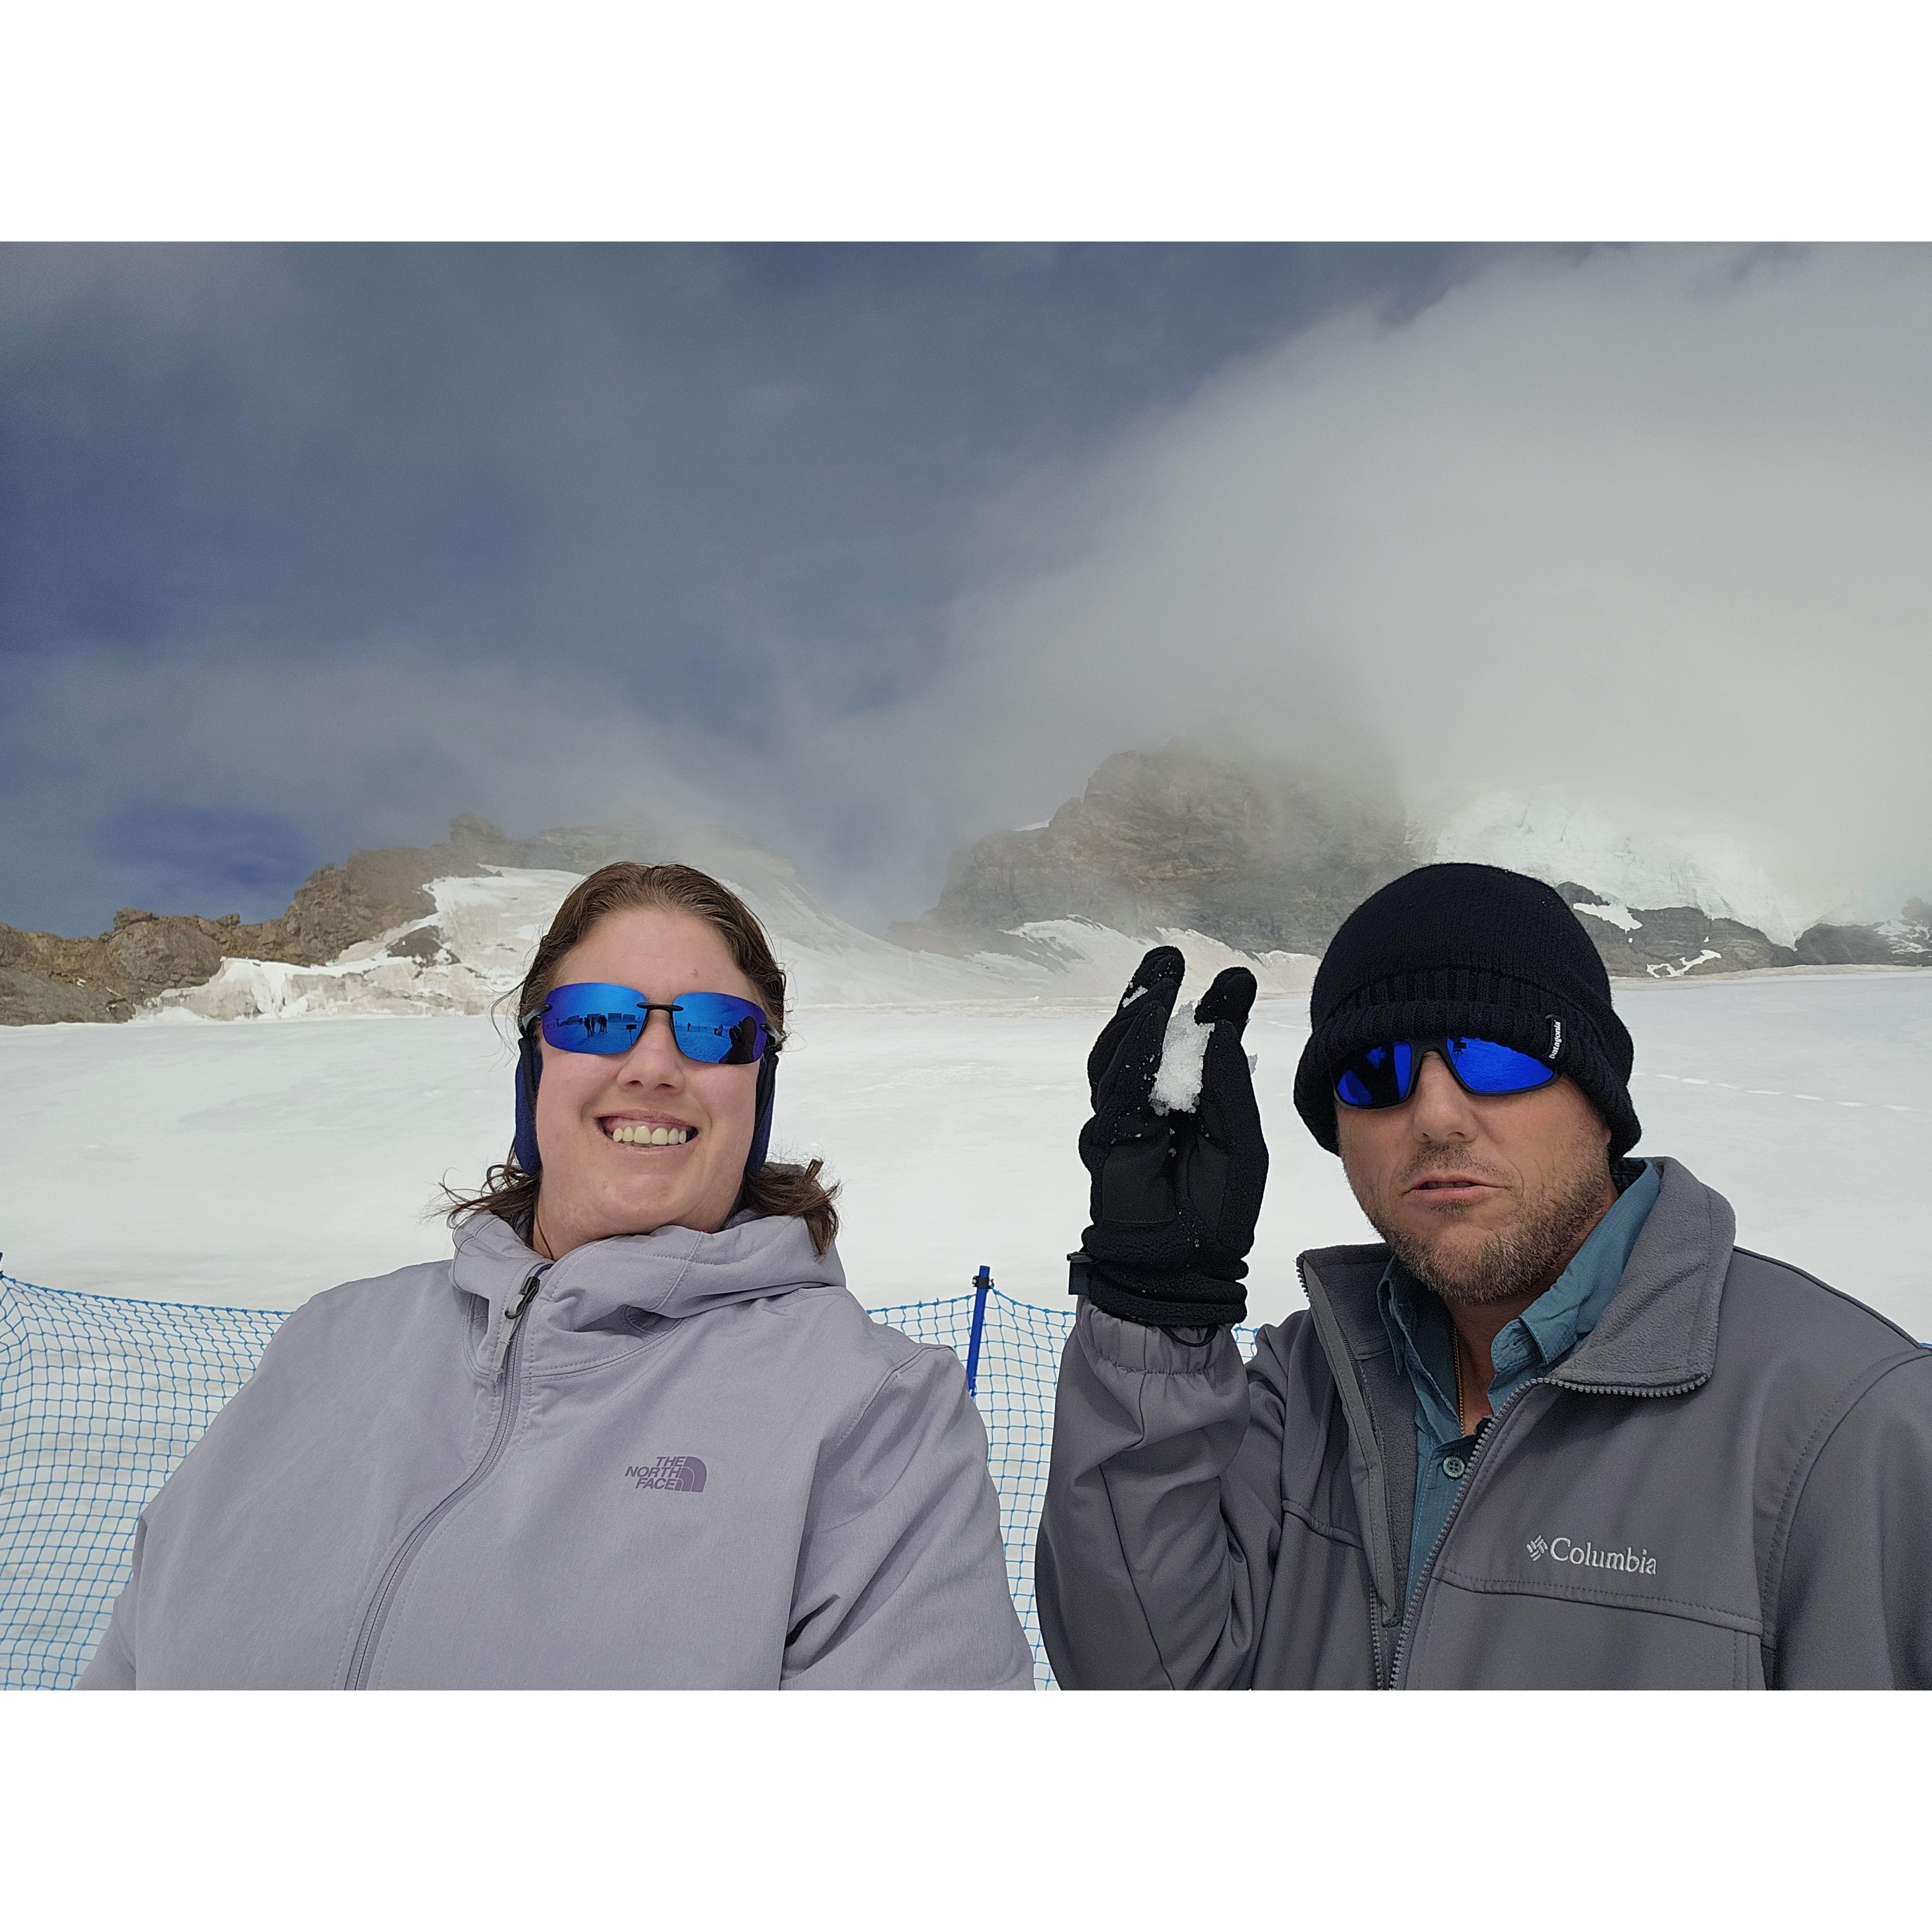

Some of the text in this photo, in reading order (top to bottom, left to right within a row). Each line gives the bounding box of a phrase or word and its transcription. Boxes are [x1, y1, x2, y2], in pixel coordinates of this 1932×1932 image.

[1548, 1021, 1562, 1059] patagonia
[656, 1456, 686, 1467] THE
[625, 1466, 682, 1478] NORTH
[635, 1478, 677, 1491] FACE
[1549, 1537, 1657, 1575] Columbia
